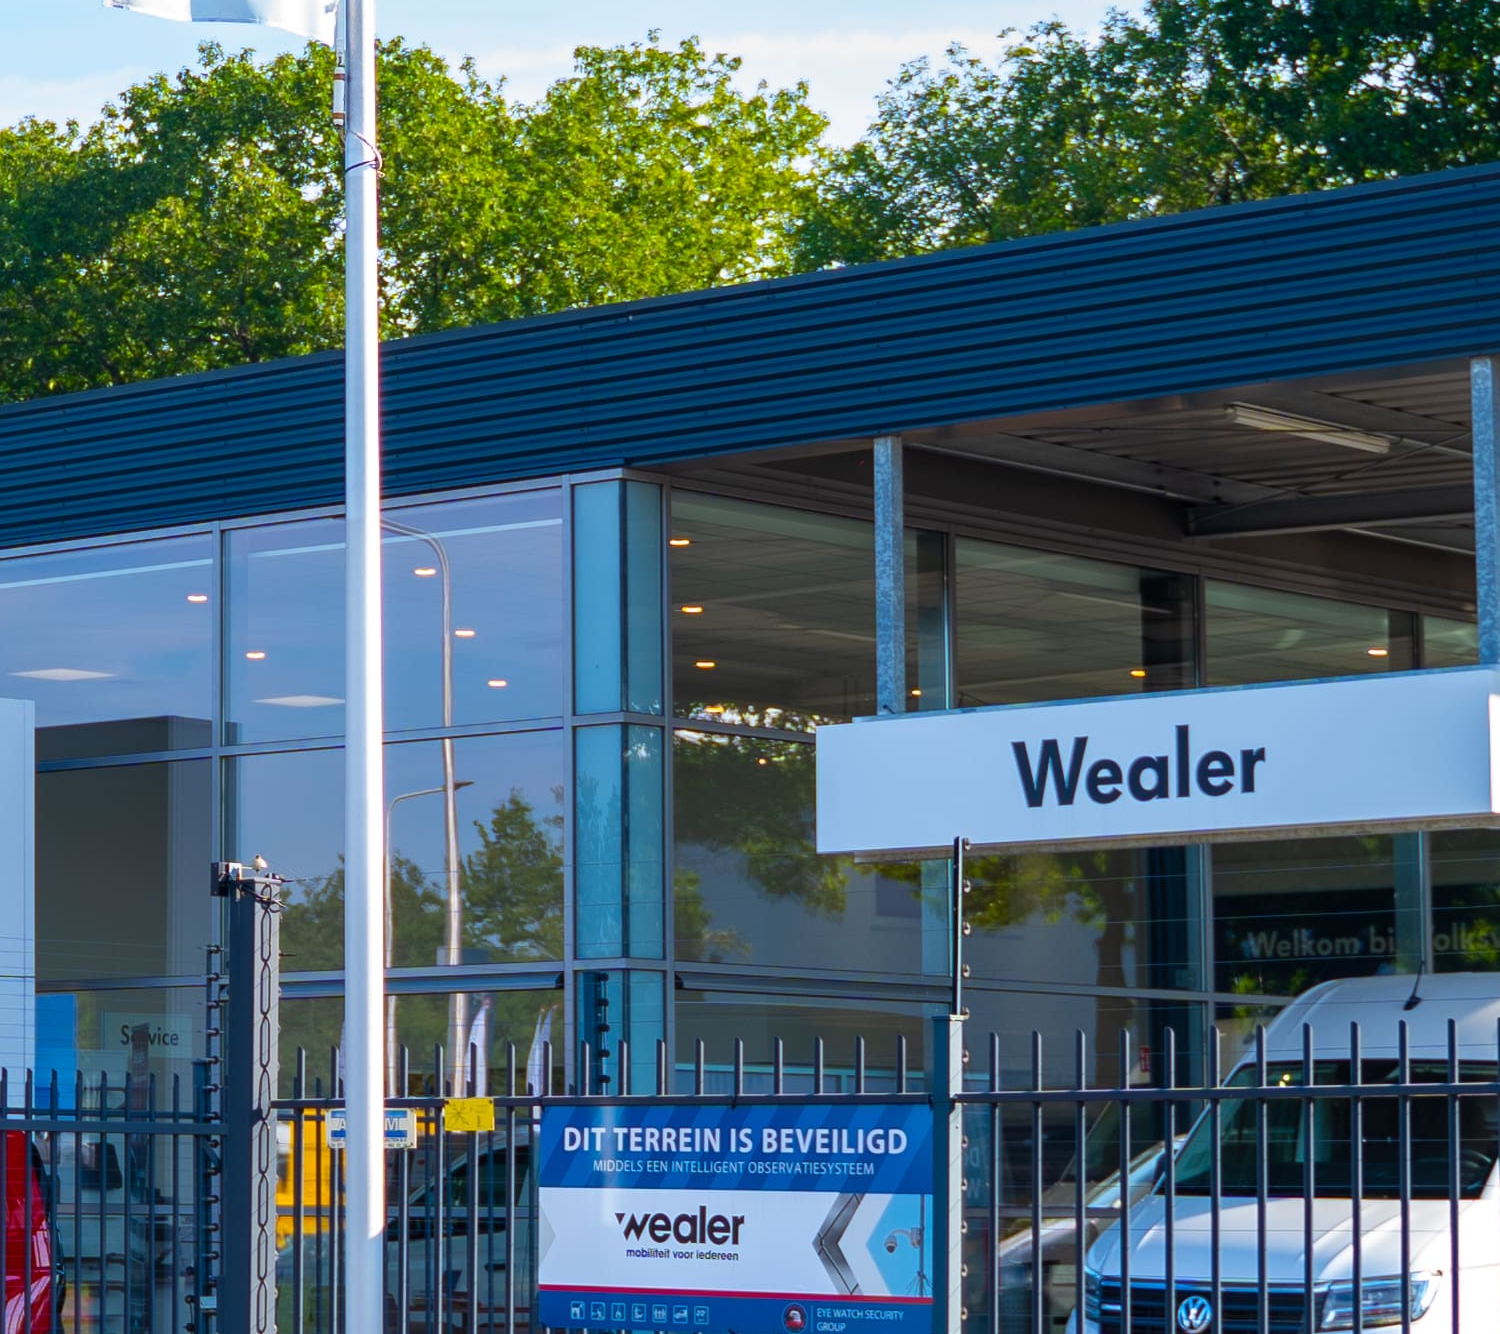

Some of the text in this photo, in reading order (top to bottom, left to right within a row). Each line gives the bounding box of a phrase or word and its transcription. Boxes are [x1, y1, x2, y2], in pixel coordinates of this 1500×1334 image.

[1011, 724, 1266, 808] Wealer
[1247, 929, 1359, 957] Welkom
[1369, 925, 1396, 954] bi
[564, 1127, 907, 1154] DIT TERREIN IS BEVEILIGD
[593, 1159, 874, 1175] MIDDELS EEN INTELLIGENT OBSERVATIESYSTEEM
[615, 1205, 744, 1245] wealer
[626, 1248, 739, 1261] mobiliteit voor iedereen
[816, 1308, 904, 1320] EYE WATCH SECURITY
[816, 1322, 846, 1332] GROUP
